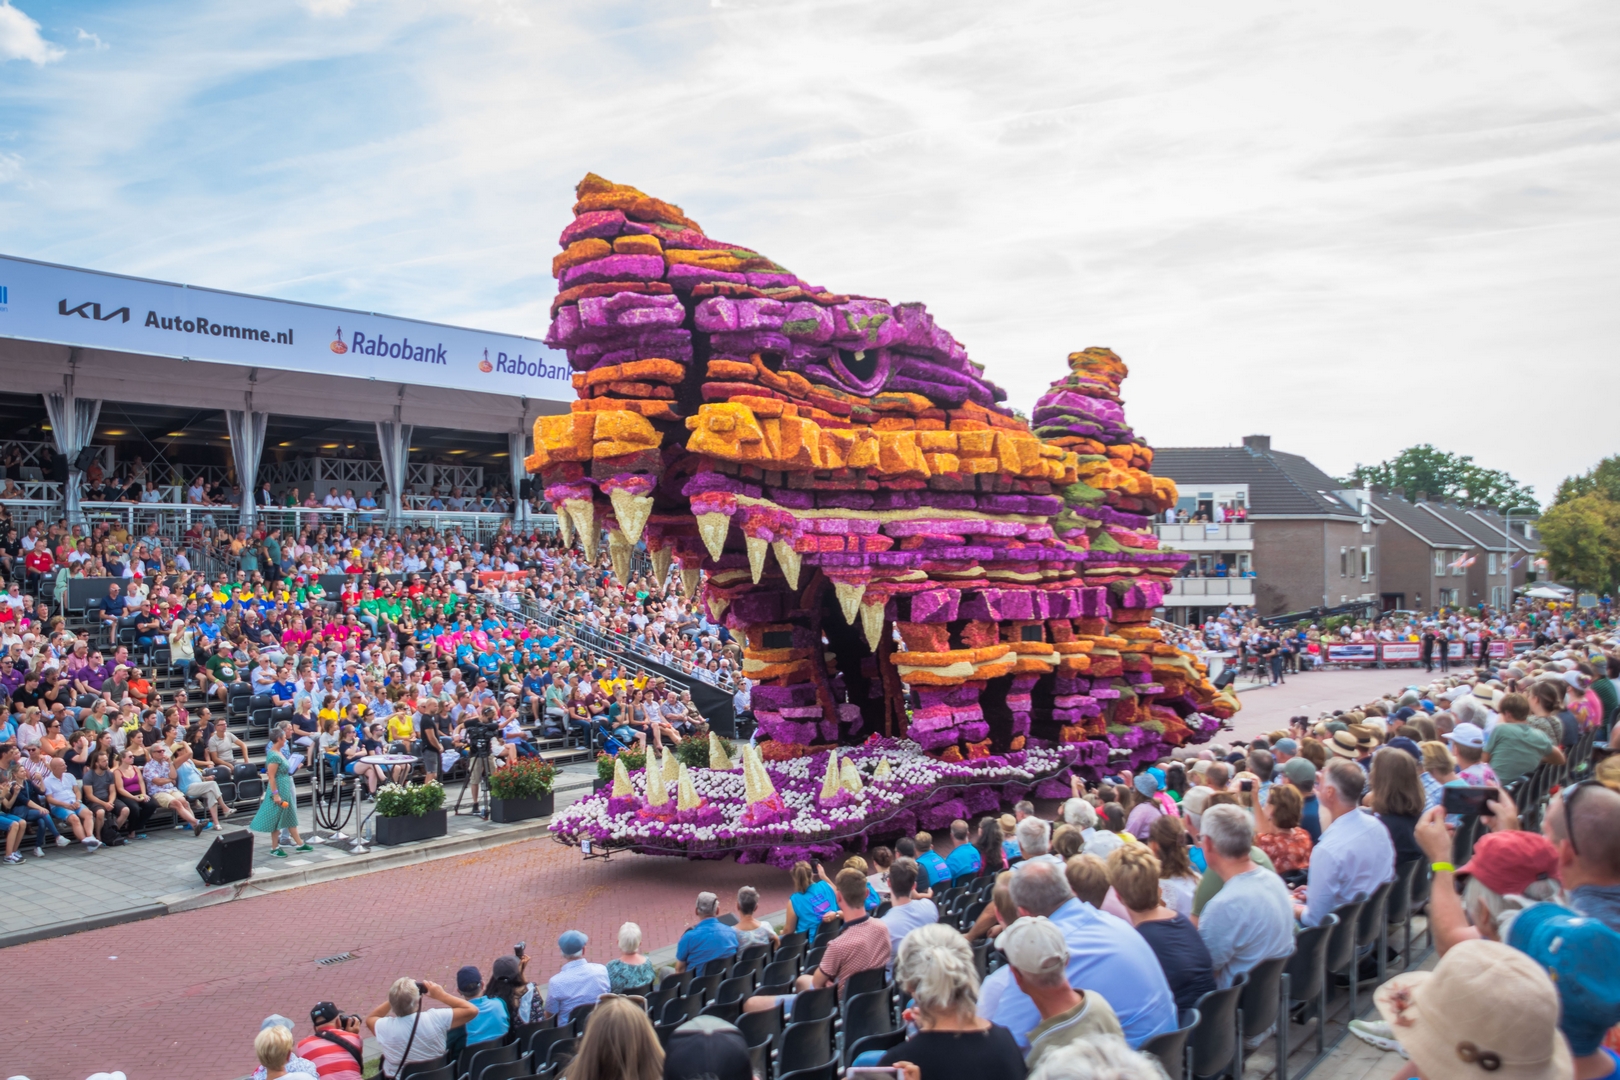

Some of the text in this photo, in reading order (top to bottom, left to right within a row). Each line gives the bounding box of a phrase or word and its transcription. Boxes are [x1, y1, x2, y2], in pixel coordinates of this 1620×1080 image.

[58, 298, 294, 346] KIA AutoRomme.nl
[351, 331, 448, 365] Rabobank
